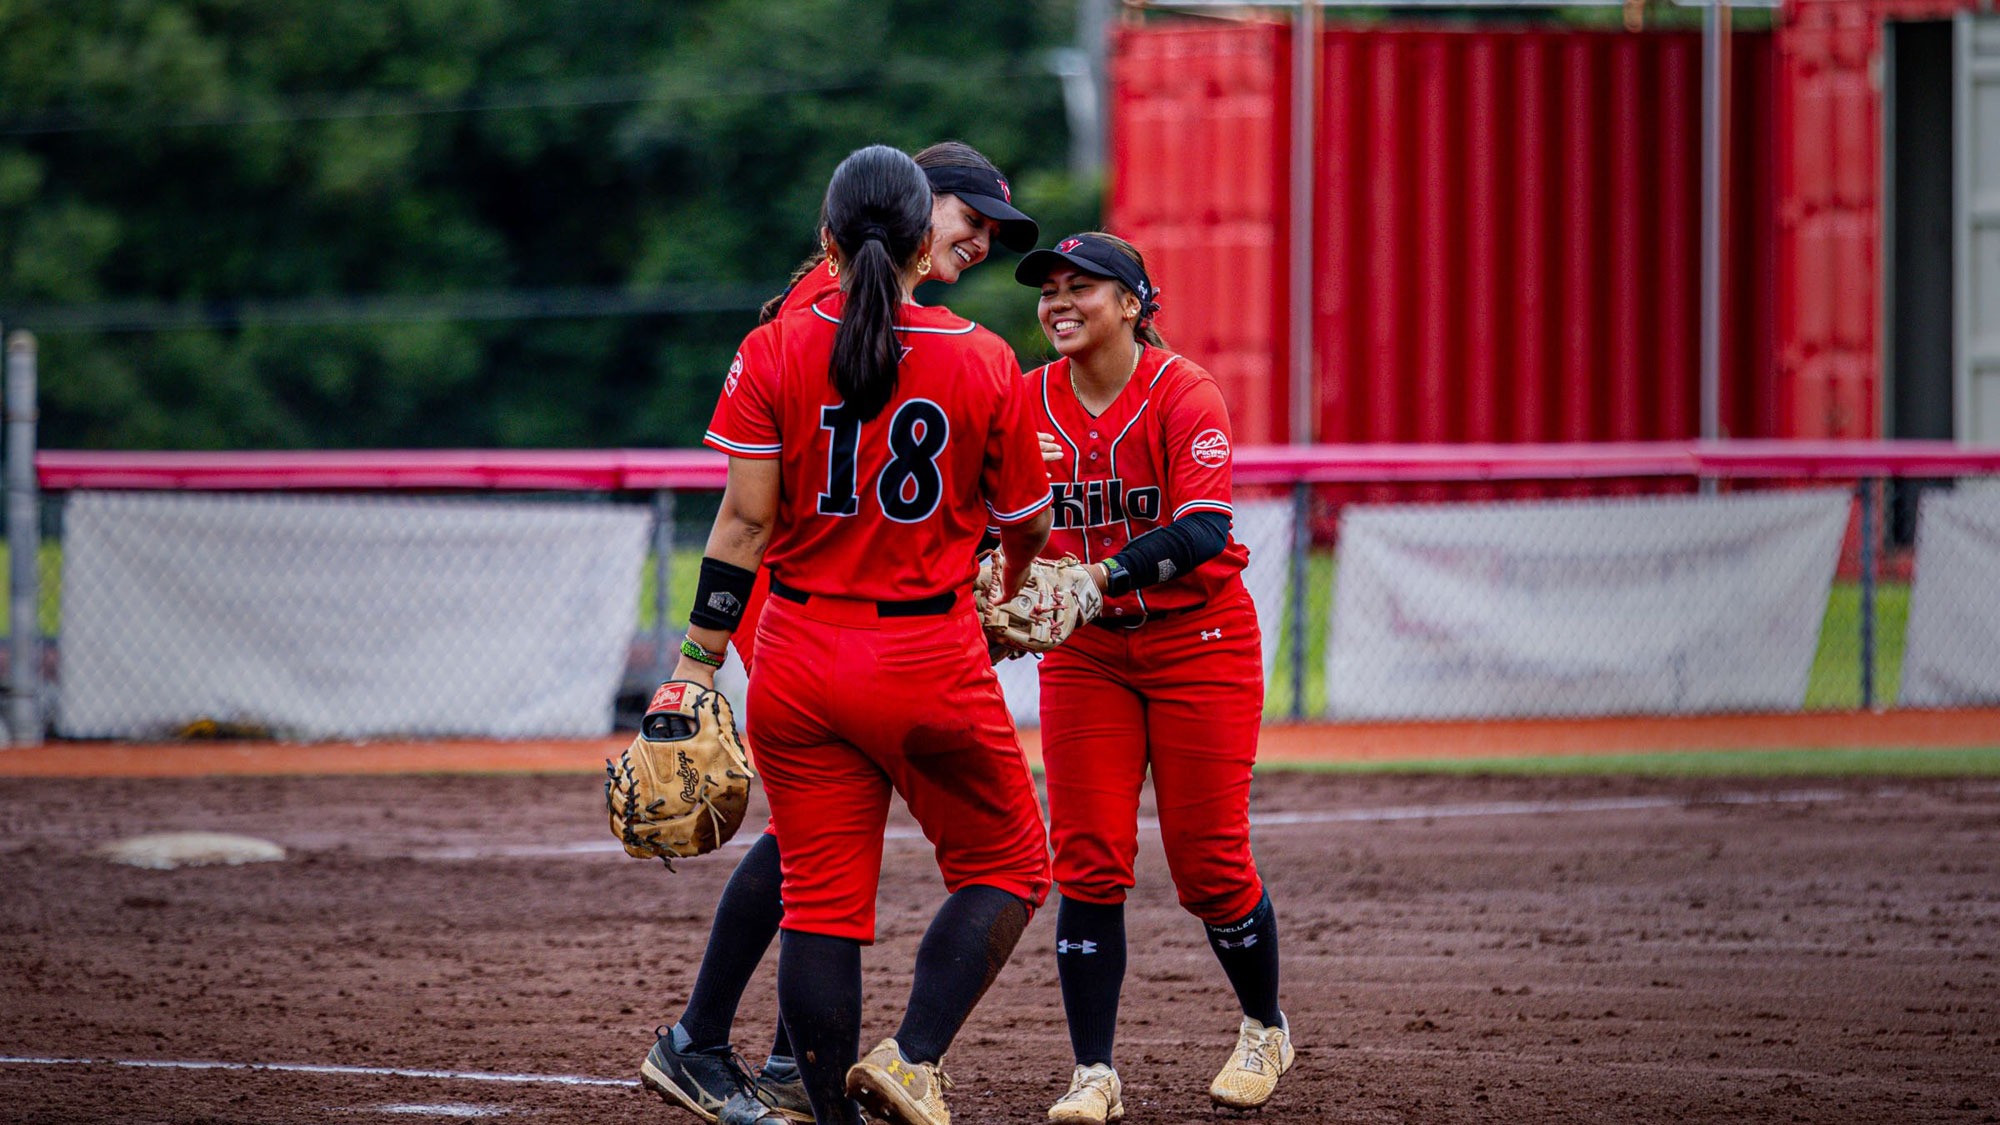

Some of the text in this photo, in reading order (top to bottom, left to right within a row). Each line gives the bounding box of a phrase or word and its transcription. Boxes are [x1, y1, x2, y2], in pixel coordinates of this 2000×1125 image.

[817, 397, 949, 523] 18
[1048, 478, 1161, 530] Hilo
[677, 750, 697, 803] Rawlings
[1212, 917, 1254, 933] MUELLER
